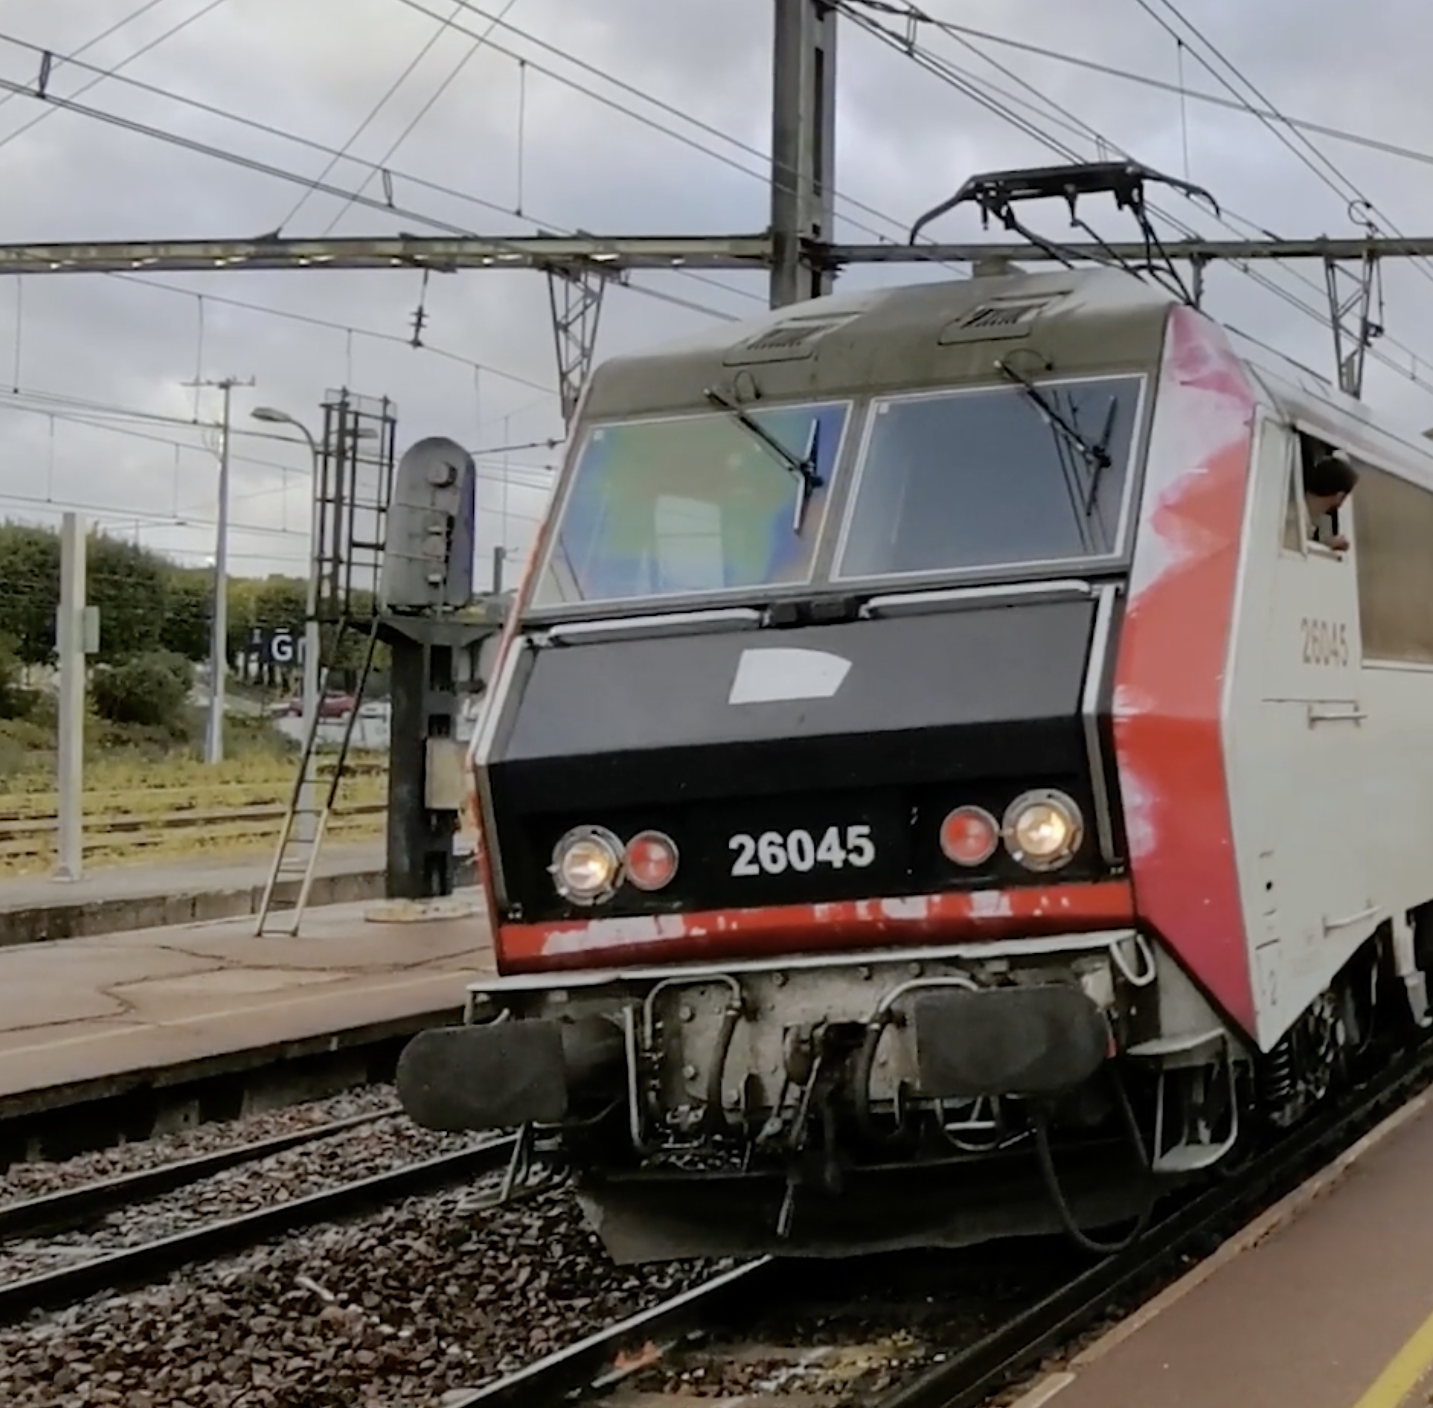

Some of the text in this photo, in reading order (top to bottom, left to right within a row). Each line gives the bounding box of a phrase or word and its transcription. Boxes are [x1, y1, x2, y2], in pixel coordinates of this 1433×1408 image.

[271, 634, 293, 662] G
[1301, 617, 1349, 667] 26045
[728, 825, 875, 876] 26045
